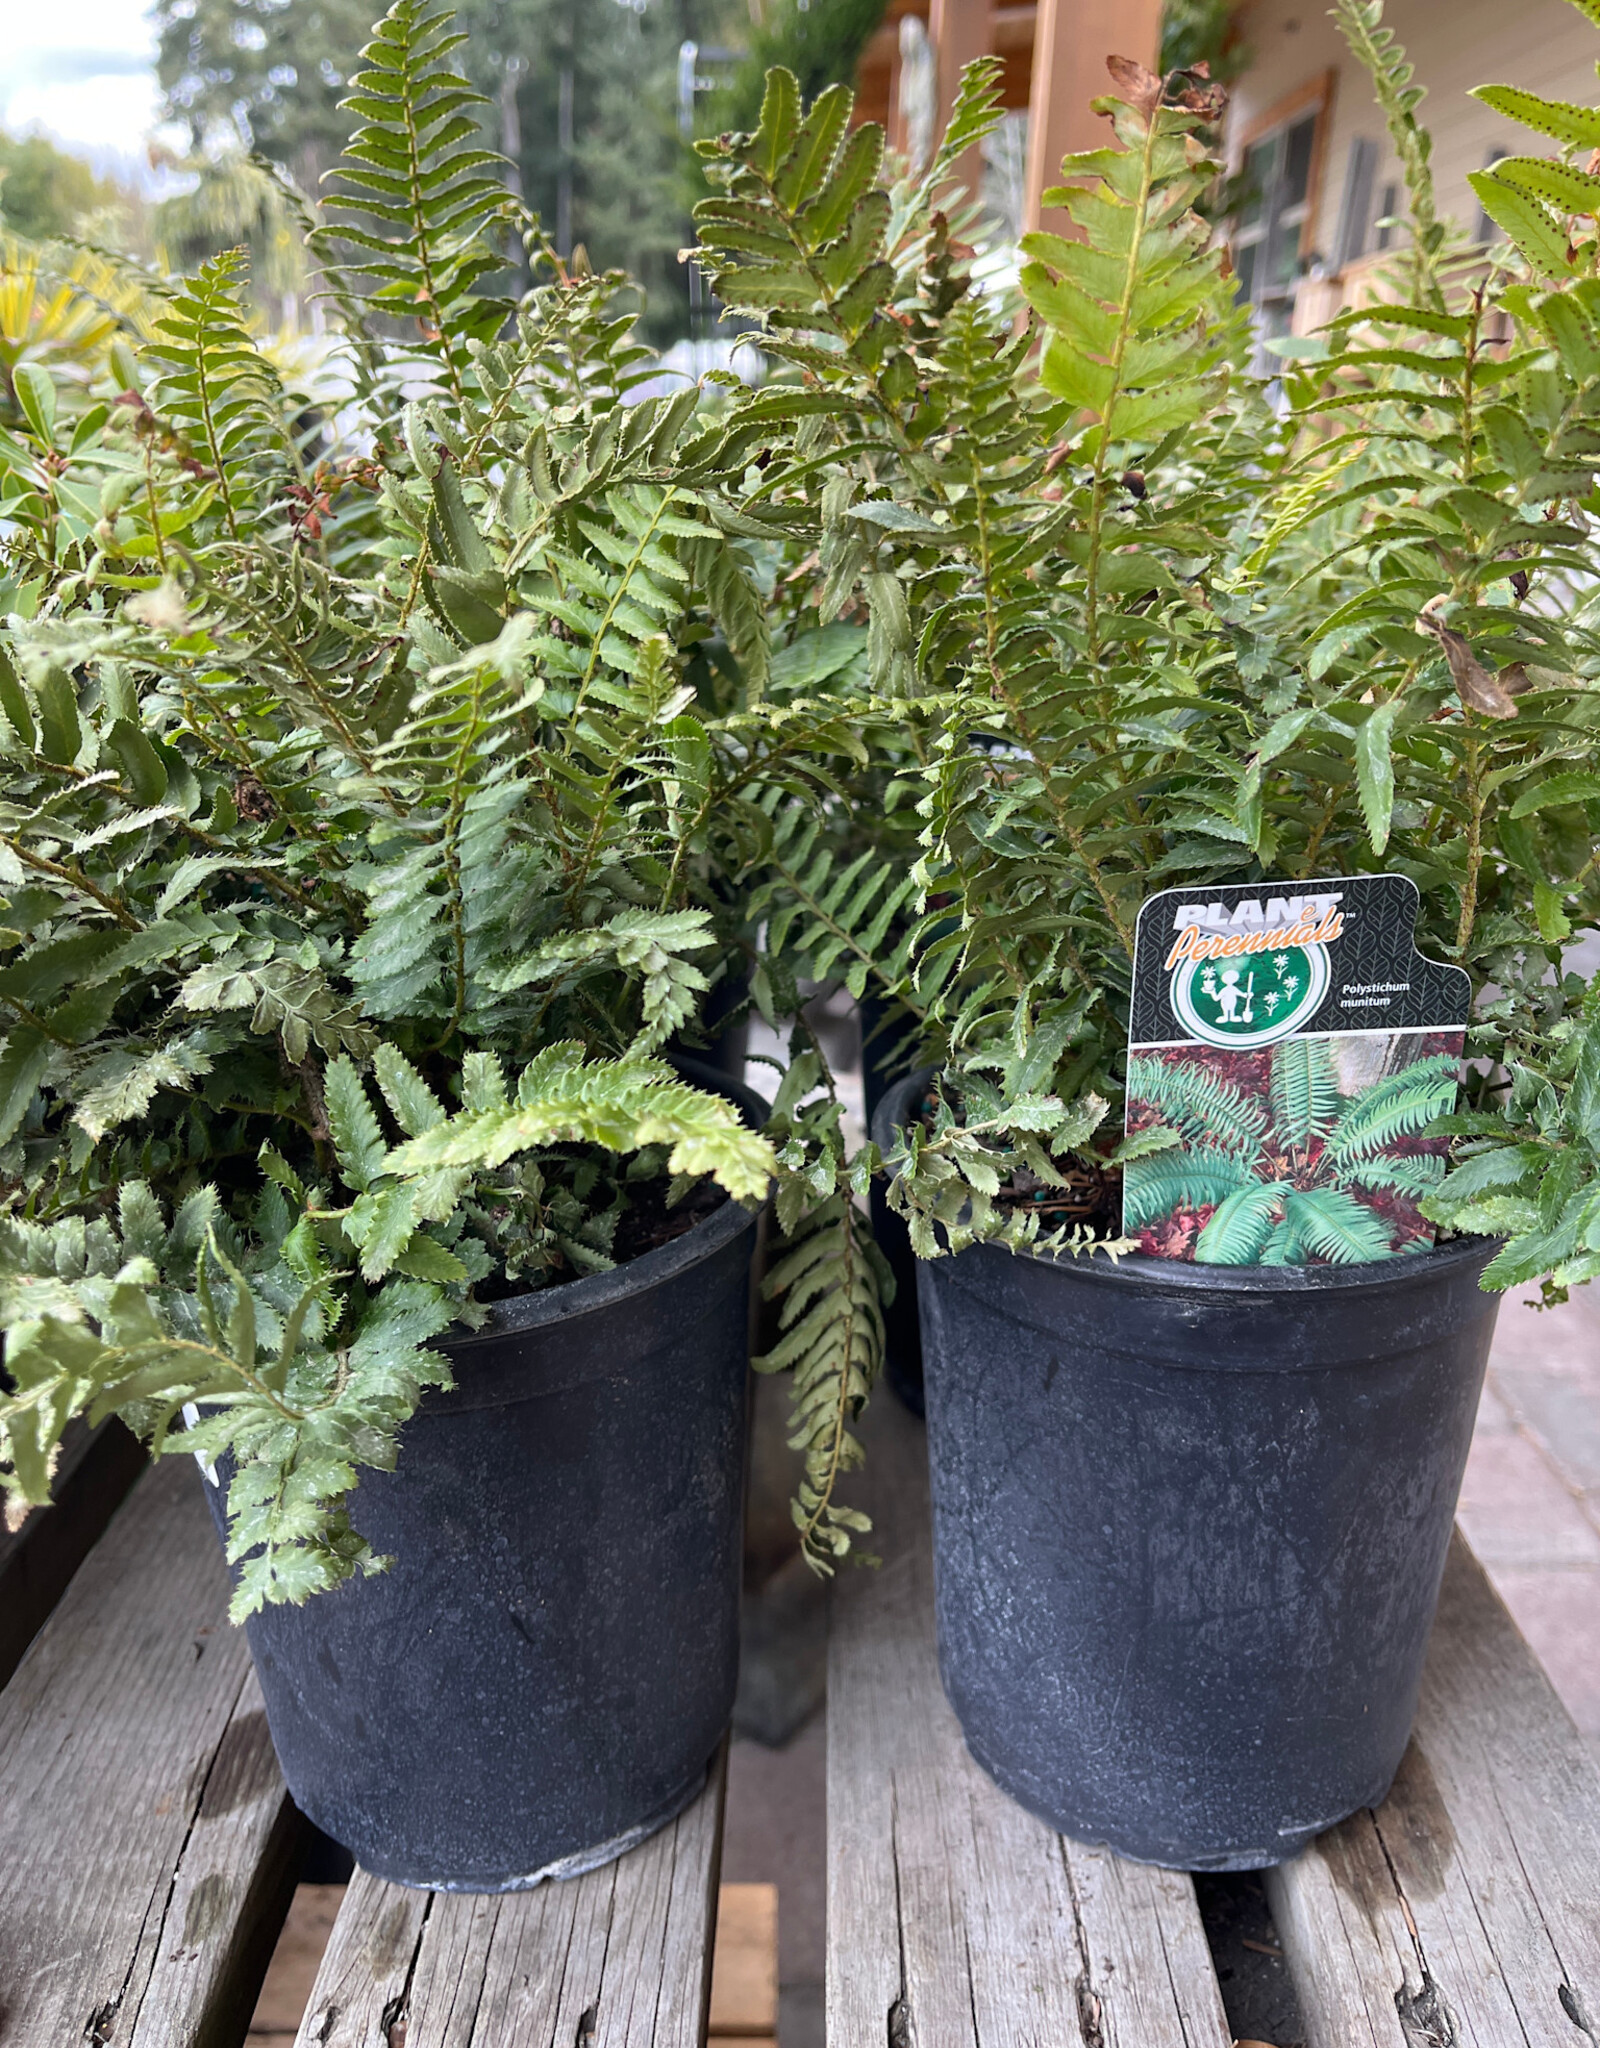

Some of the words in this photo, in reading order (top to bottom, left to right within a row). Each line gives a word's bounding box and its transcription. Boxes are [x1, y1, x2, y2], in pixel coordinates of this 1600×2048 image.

[1164, 904, 1344, 971] Perennials
[1342, 982, 1410, 996] Polystichum
[1340, 996, 1391, 1008] munitum
